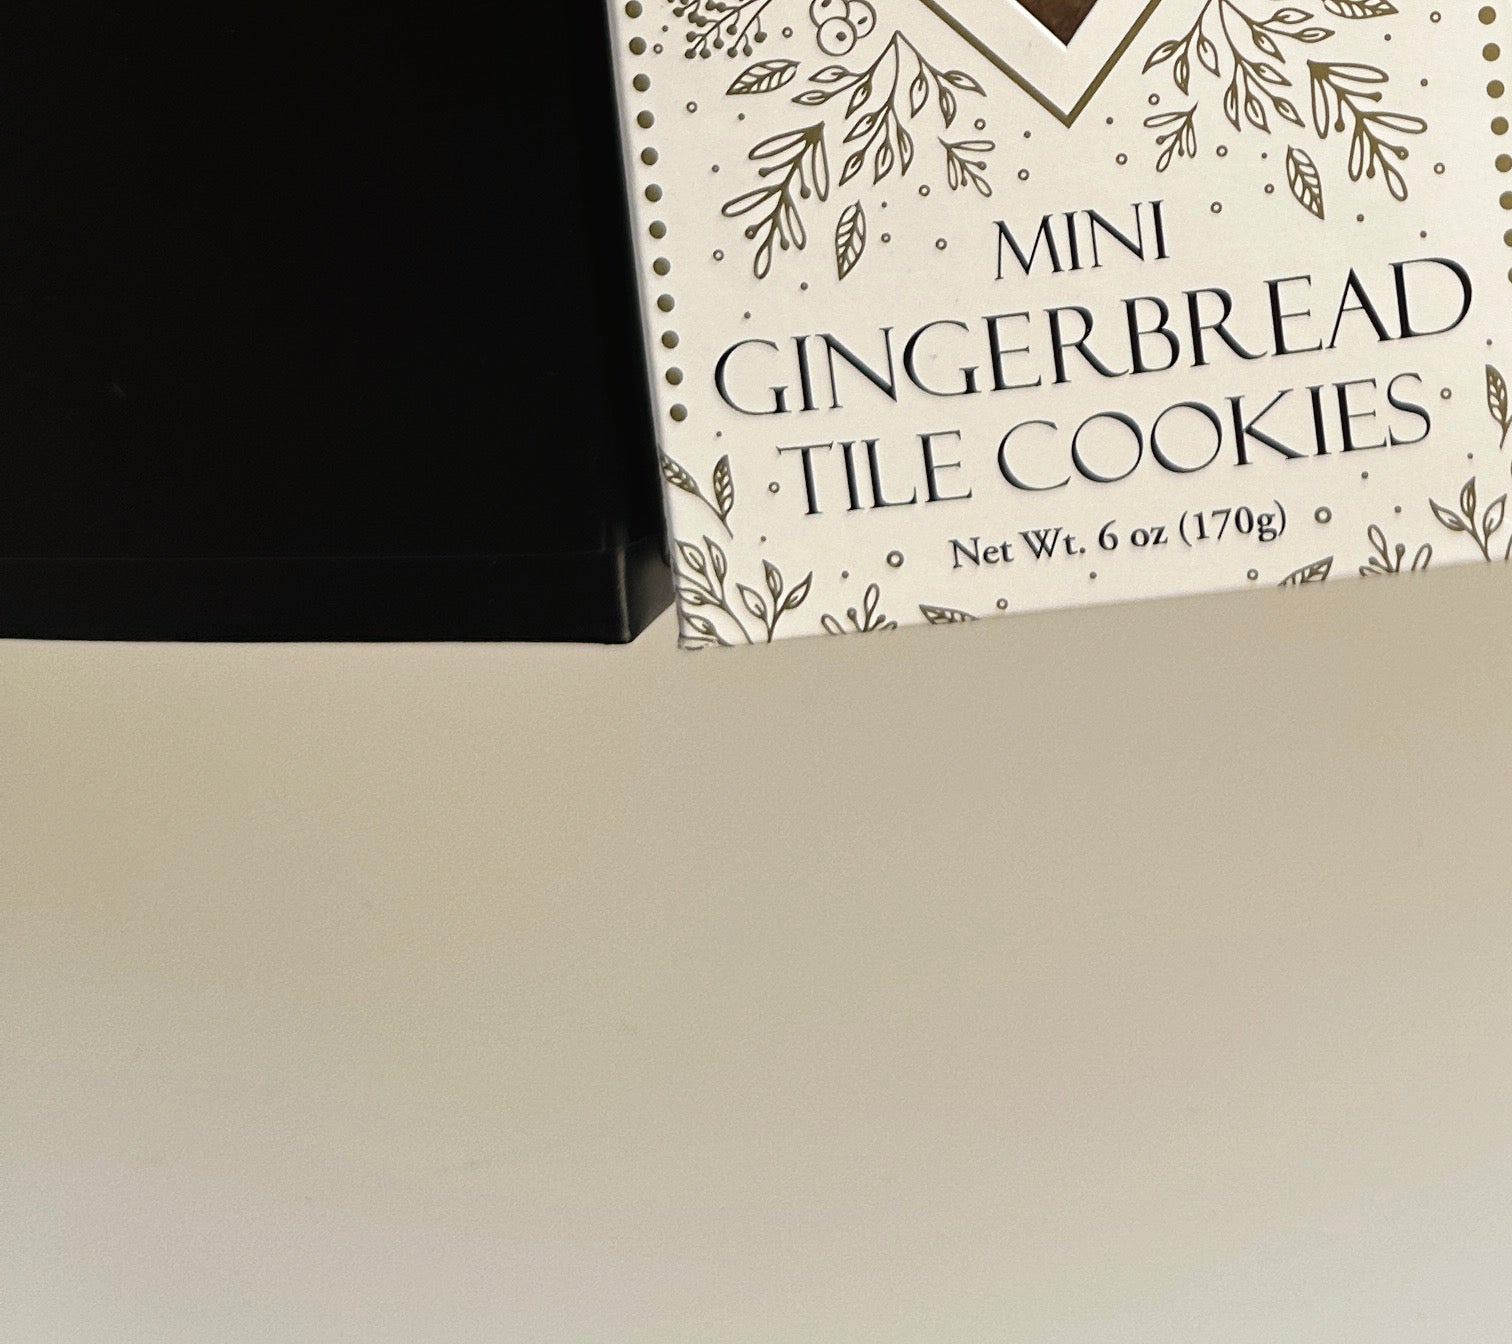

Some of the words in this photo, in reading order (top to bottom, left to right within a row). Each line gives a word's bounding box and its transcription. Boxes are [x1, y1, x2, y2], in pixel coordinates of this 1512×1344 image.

[992, 199, 1171, 280] MINI
[714, 256, 1474, 417] GINGERBREAD
[776, 428, 972, 516] TILE
[997, 372, 1432, 492] COOKIES
[950, 536, 1014, 569] Net
[1019, 526, 1086, 560] Wt.
[1099, 519, 1119, 552] 6
[1130, 524, 1169, 548] oz
[1178, 499, 1287, 547] (170g)
